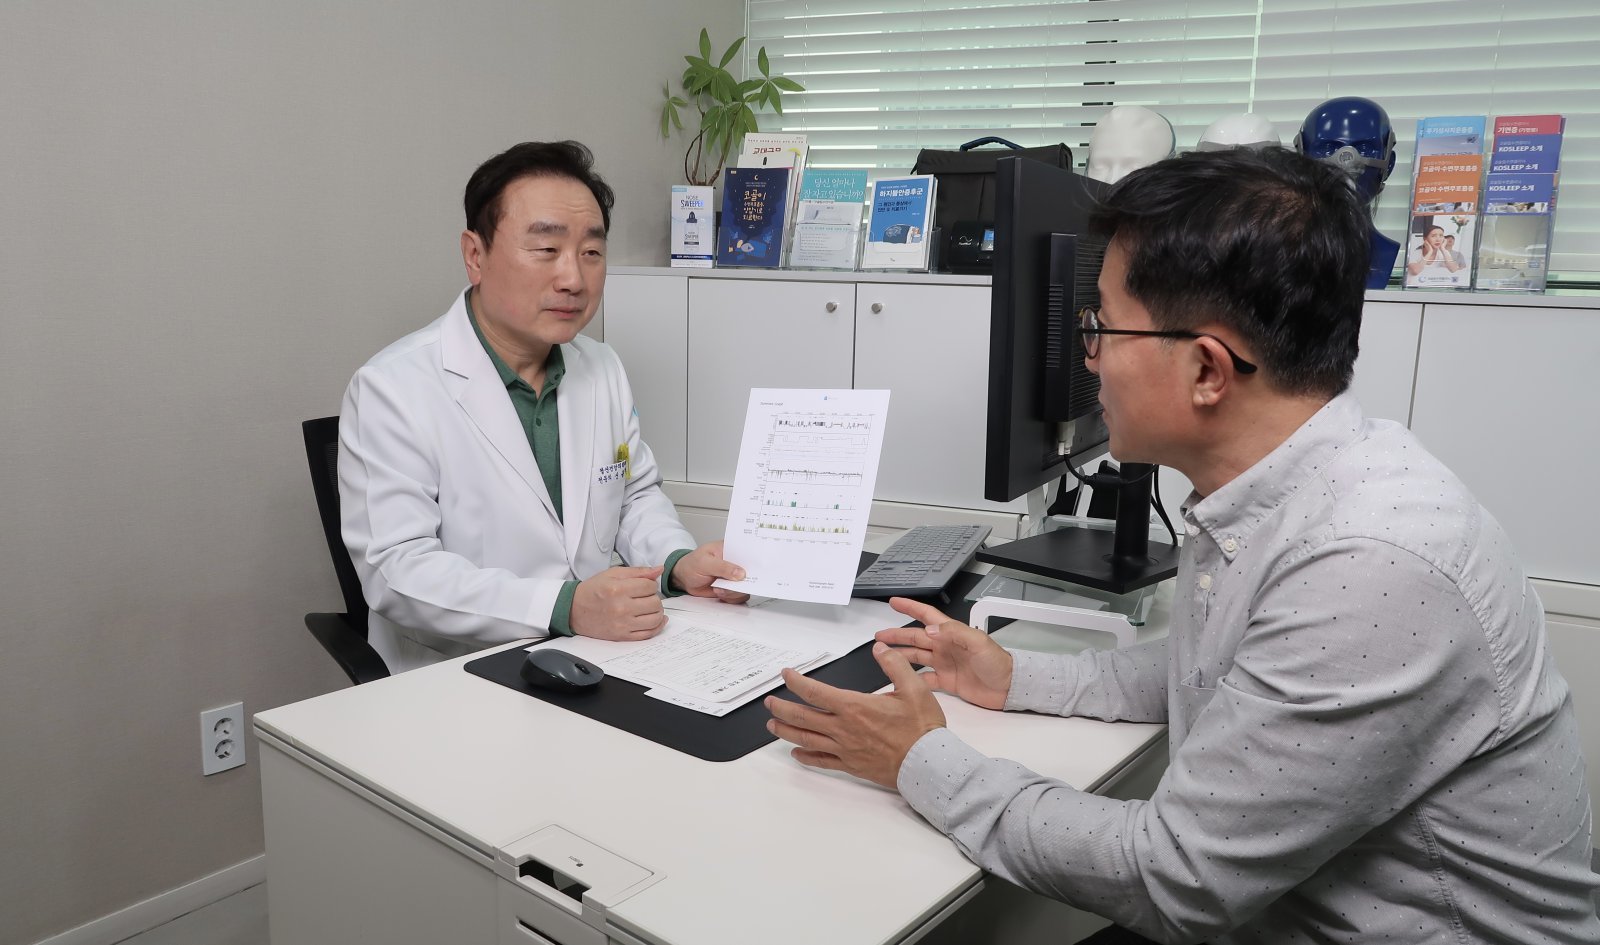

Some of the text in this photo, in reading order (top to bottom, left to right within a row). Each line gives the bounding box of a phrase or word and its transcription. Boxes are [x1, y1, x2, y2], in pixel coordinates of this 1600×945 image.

[1497, 126, 1518, 134] 기면증
[814, 178, 856, 188] 당신 얼마나
[744, 189, 767, 202] 코골이
[879, 187, 923, 197] 하지불안증후군
